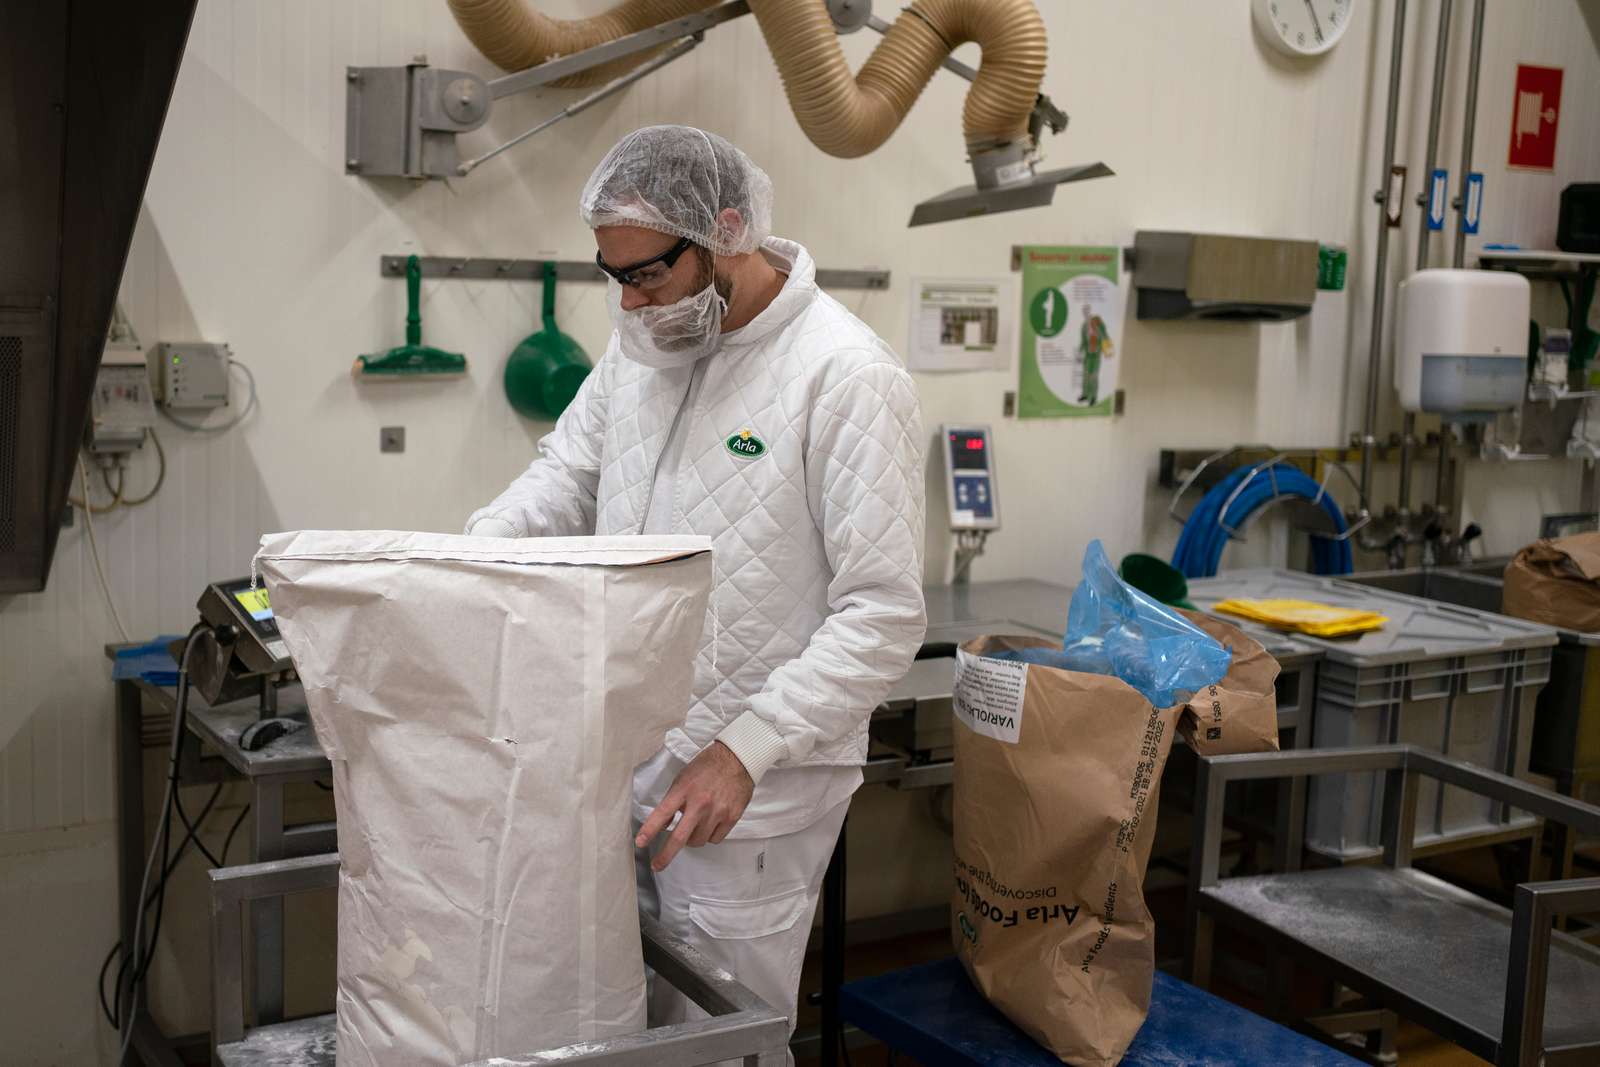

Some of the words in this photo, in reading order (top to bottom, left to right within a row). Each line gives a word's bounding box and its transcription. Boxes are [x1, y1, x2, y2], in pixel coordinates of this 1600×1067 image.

[732, 438, 757, 453] Arla
[985, 871, 1057, 900] Discovering
[970, 888, 1019, 928] Foods
[1025, 904, 1080, 926] Arla
